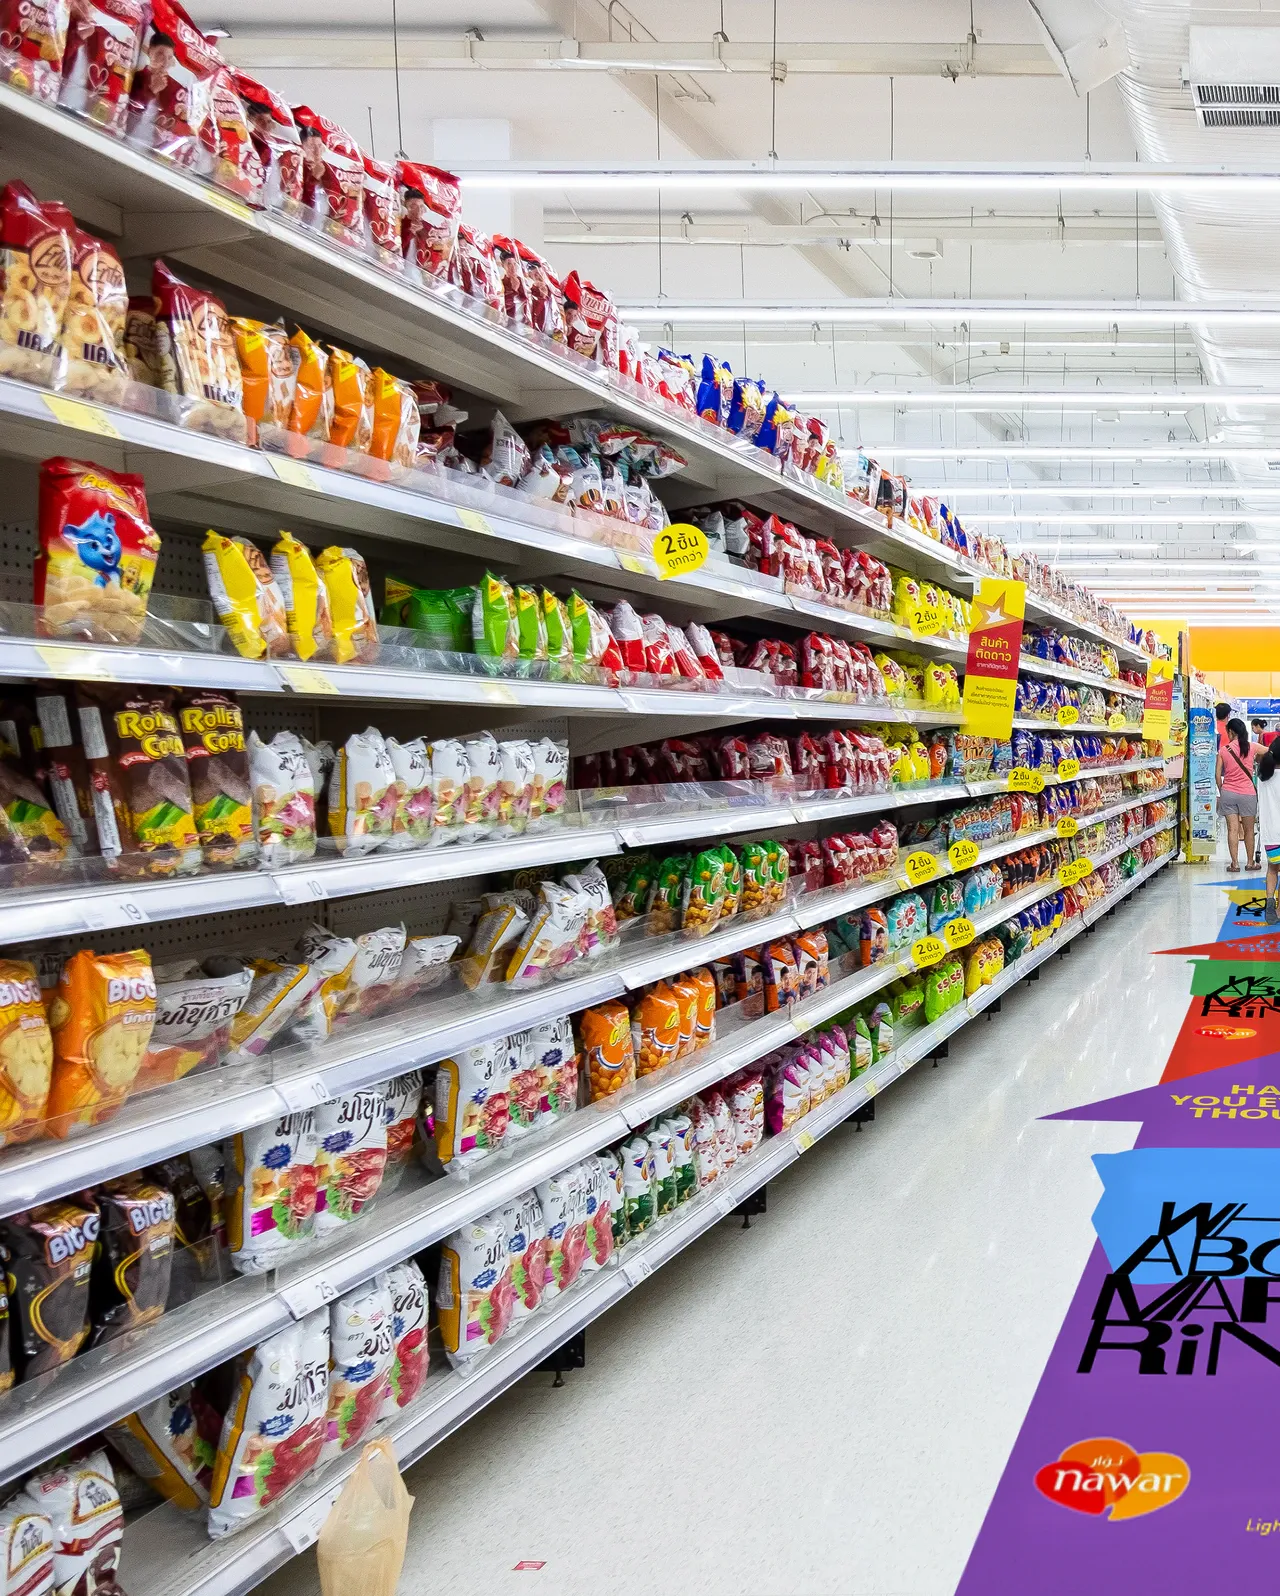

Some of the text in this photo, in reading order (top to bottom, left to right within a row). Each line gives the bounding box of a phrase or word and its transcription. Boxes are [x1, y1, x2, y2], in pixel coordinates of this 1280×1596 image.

[661, 533, 699, 555] 2 ชิ้น
[667, 552, 703, 569] ถูกกว่า
[914, 612, 923, 624] 2
[980, 636, 1009, 649] สินค้า
[975, 648, 1012, 662] ติดดาว
[953, 847, 961, 858] 2
[908, 859, 917, 870] 2
[306, 880, 322, 896] 10
[120, 903, 142, 920] 19
[949, 925, 957, 935] 2
[916, 944, 925, 954] 2
[311, 1082, 326, 1099] 10
[1169, 1094, 1253, 1107] YOU
[315, 1281, 334, 1300] 25
[1053, 1468, 1183, 1494] nawar
